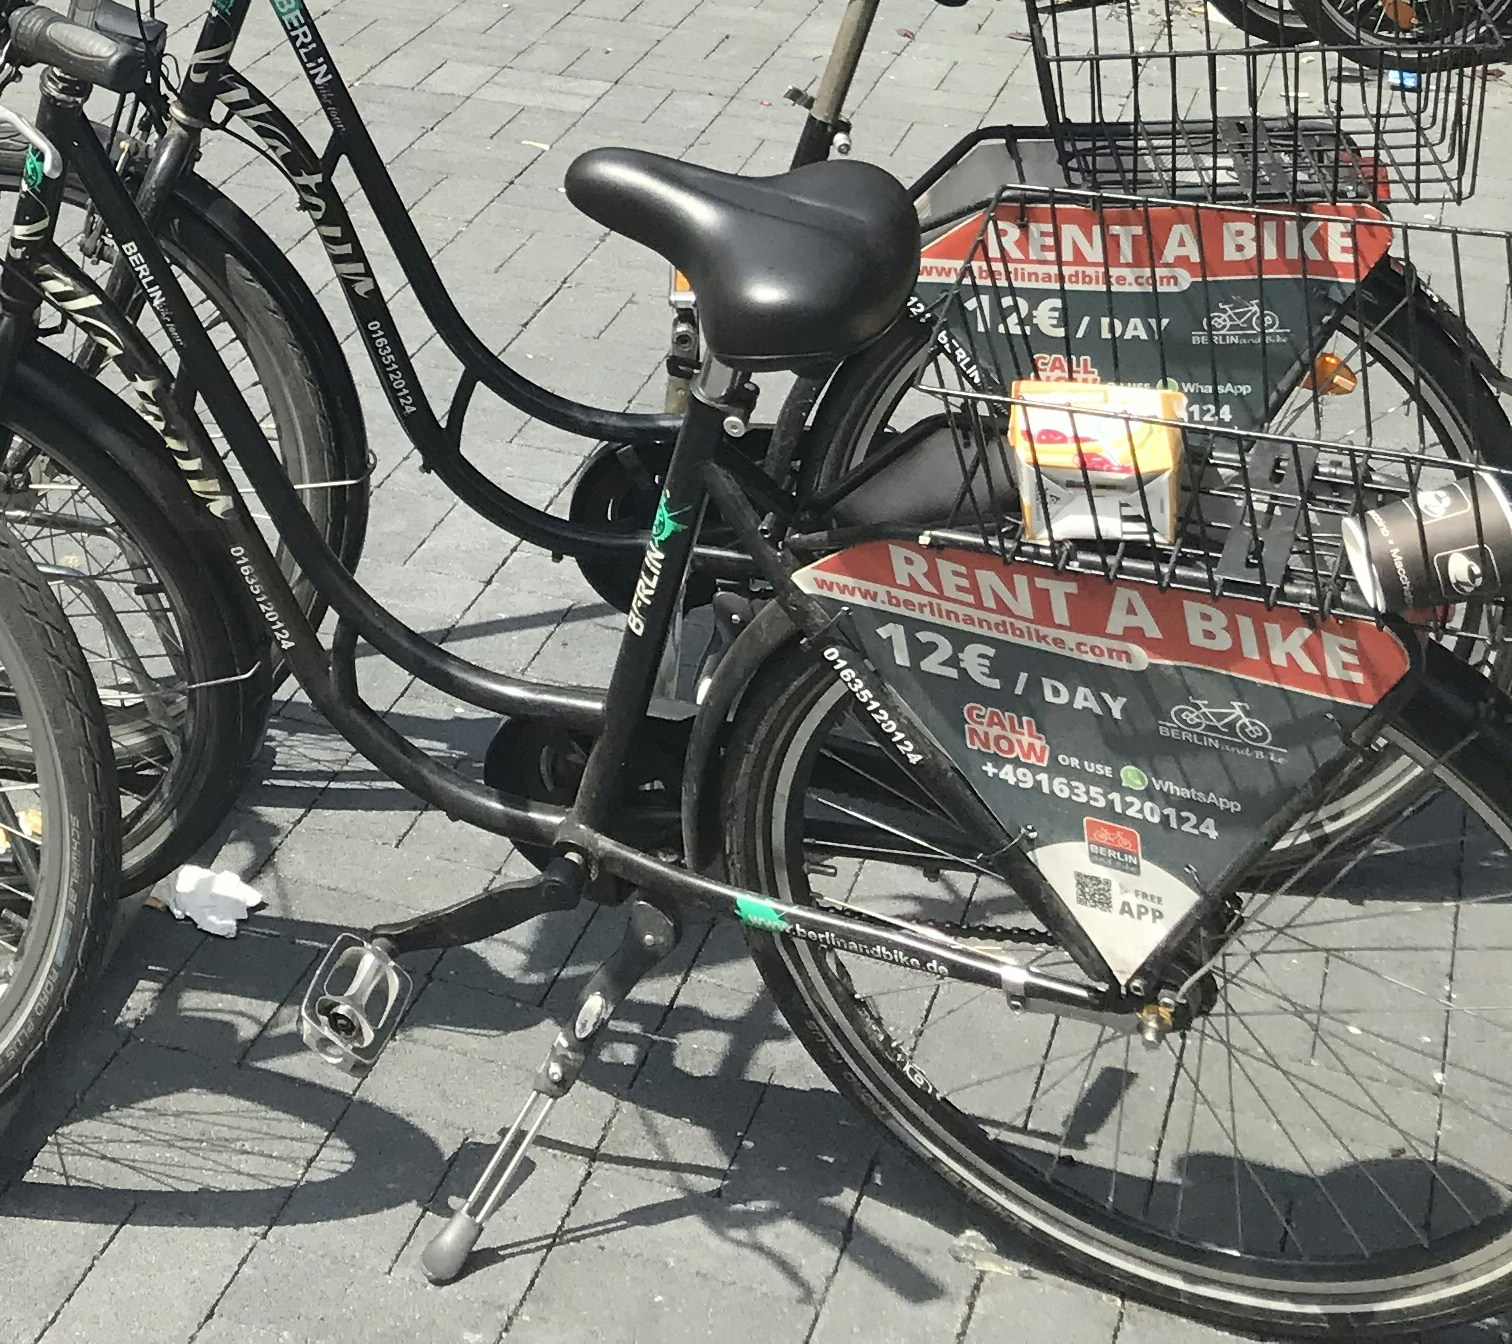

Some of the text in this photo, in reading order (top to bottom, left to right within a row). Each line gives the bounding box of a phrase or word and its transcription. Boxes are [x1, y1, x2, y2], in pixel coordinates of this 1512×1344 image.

[988, 220, 1356, 265] RENT A BIKE
[120, 239, 167, 310] BERLIN
[919, 262, 1179, 289] www.berlinandbike.com
[963, 294, 1171, 341] 12€ / DAY
[367, 318, 417, 417] 01635120124
[1032, 352, 1097, 377] CALL
[1181, 380, 1252, 398] WhasApp
[228, 544, 297, 653] 01635120124
[813, 574, 1134, 667] www.berlinandbike.com
[888, 543, 1367, 685] RENT A BIKE
[875, 621, 1128, 721] 12€ / DAY
[823, 647, 924, 765] 01635120124
[964, 703, 1045, 742] CALL
[1158, 724, 1220, 749] BERLIN
[964, 723, 1242, 814] NOW OR USE WhatsApp
[981, 760, 1219, 840] +491635120124
[1089, 843, 1138, 866] BERLIN
[1119, 900, 1165, 925] APP
[1134, 888, 1164, 906] FREE
[748, 914, 949, 976] www.berlinandbike.de
